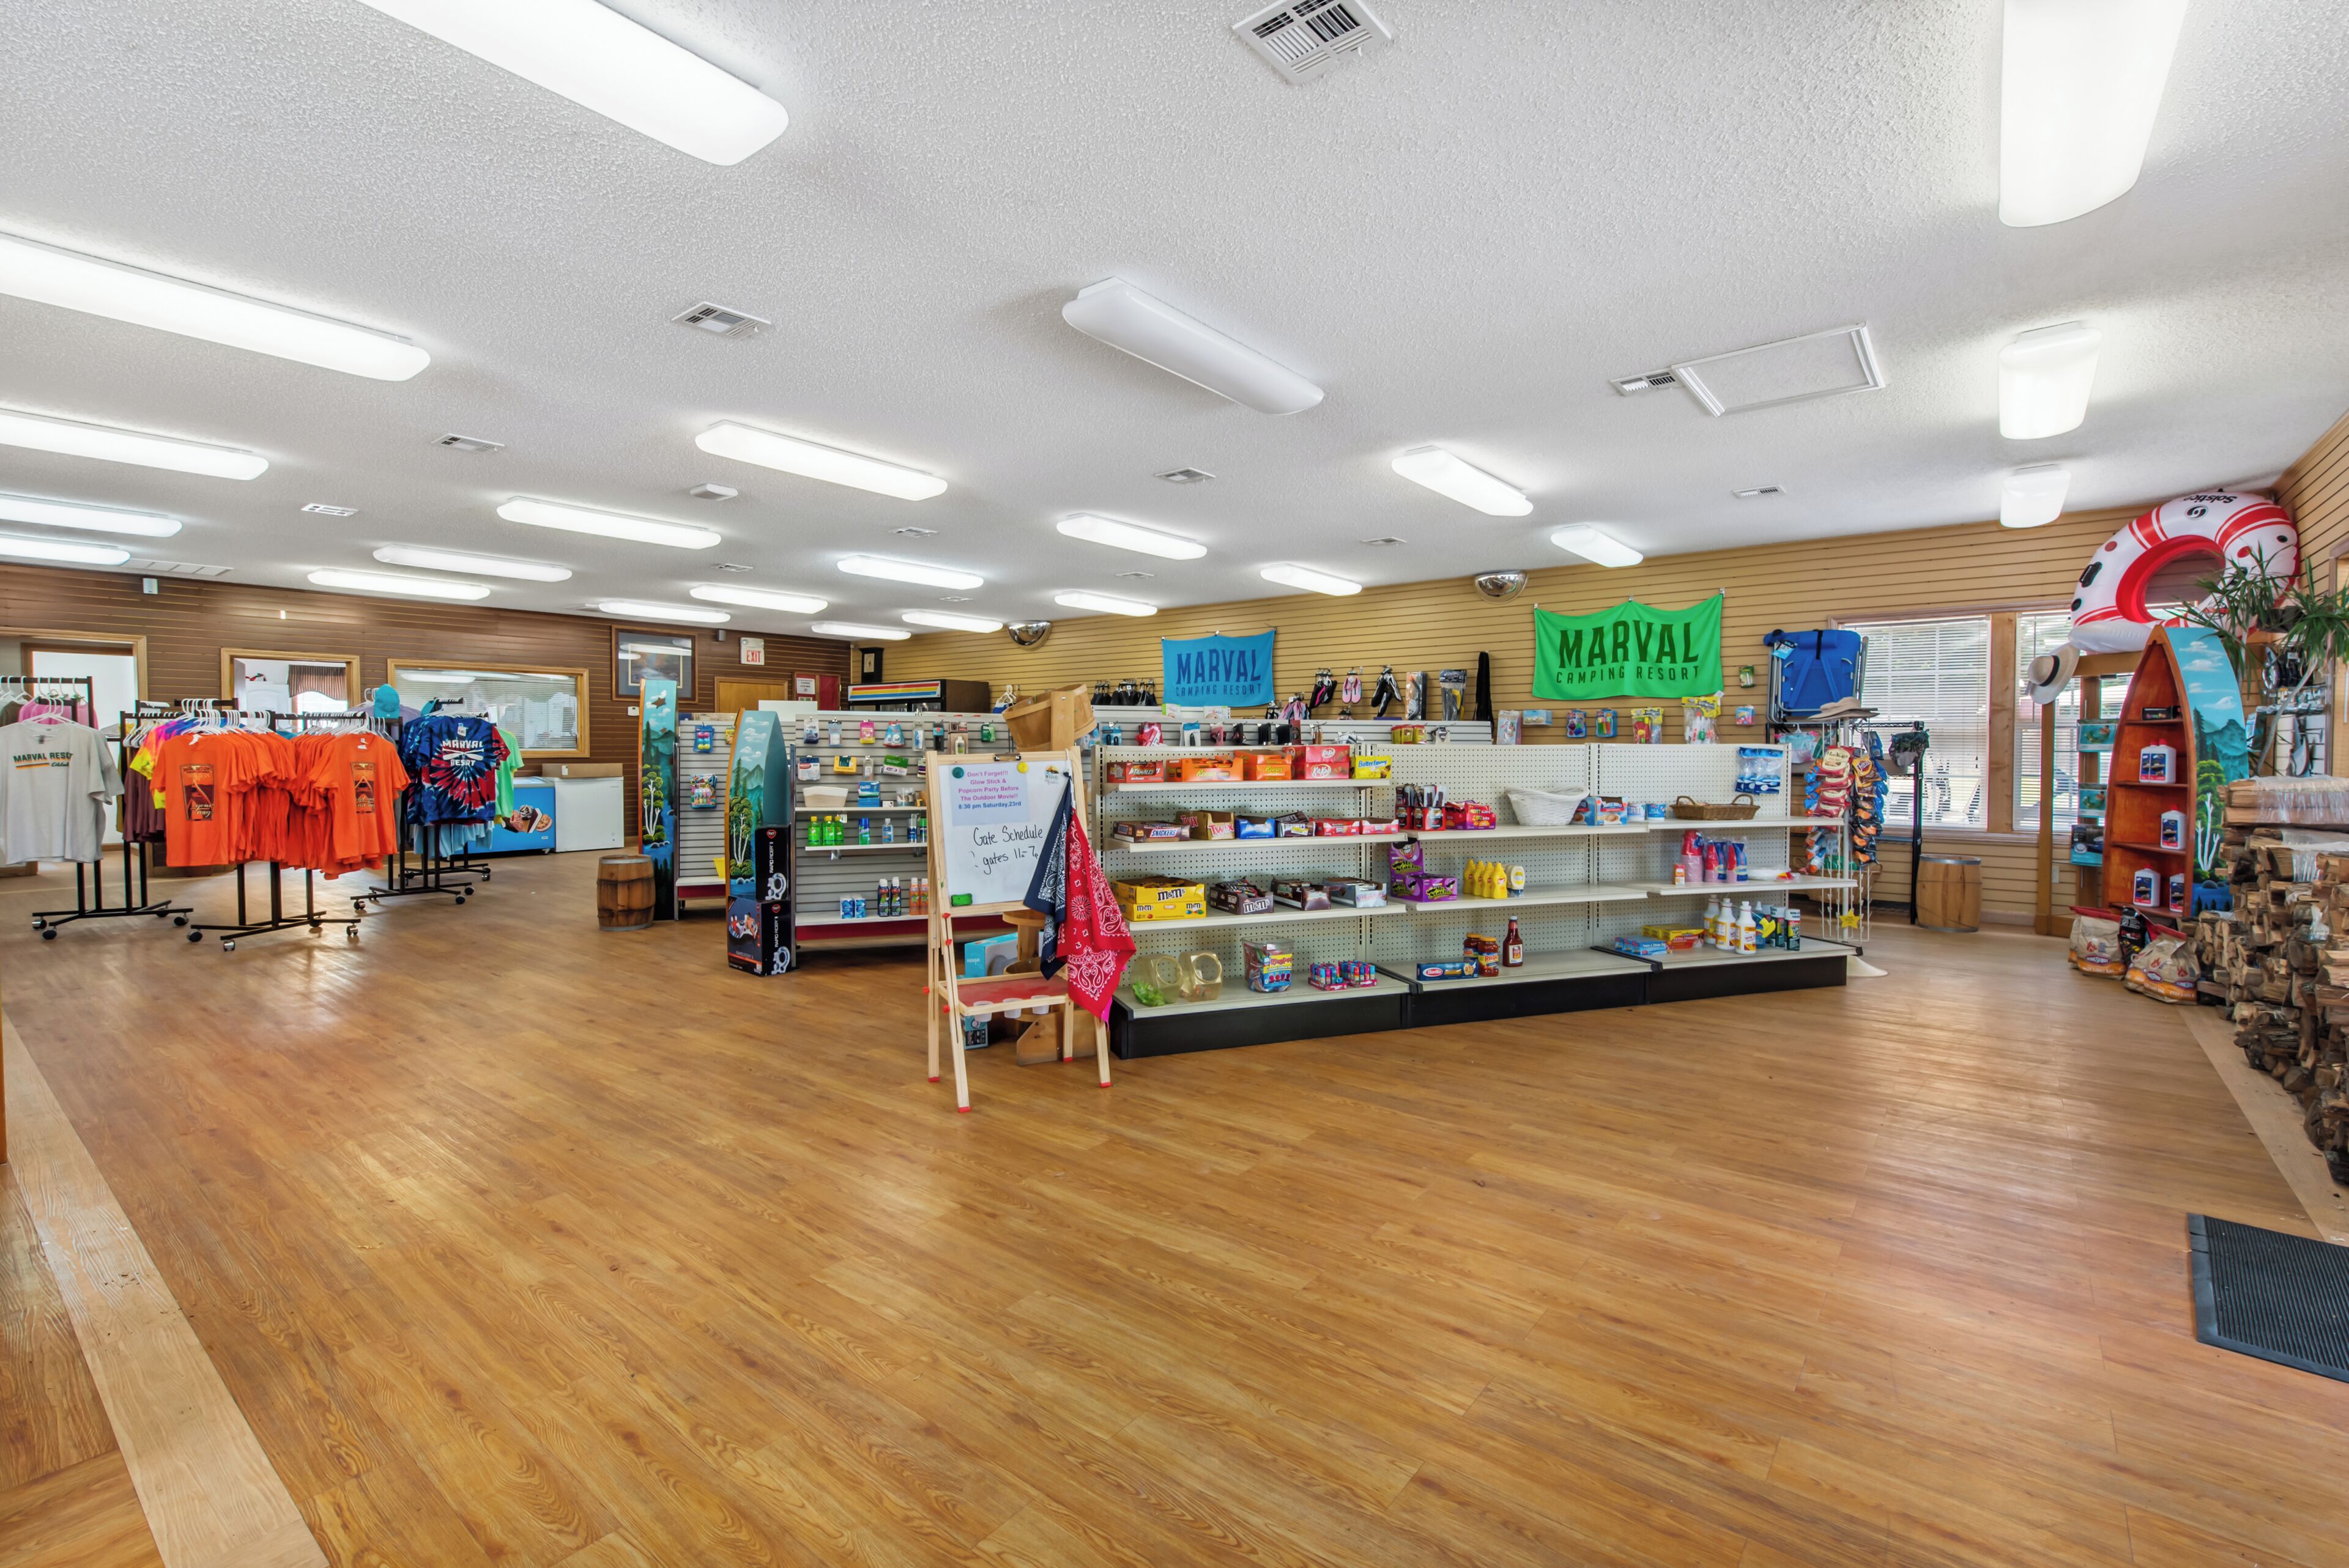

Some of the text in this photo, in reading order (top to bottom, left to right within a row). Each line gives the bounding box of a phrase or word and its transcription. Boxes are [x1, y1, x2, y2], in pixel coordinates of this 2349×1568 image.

[1558, 619, 1699, 668] MARVAL
[746, 650, 761, 662] EXIT
[1176, 648, 1261, 685] MARVAL
[1556, 665, 1699, 684] CAMPING RESORT
[1176, 683, 1261, 697] CAMPING RESORT
[442, 740, 483, 749] MARVAL
[13, 753, 48, 763] MARVAL
[50, 752, 73, 760] RESO
[973, 824, 1043, 846] Gate Schedule
[982, 852, 1009, 875] gates
